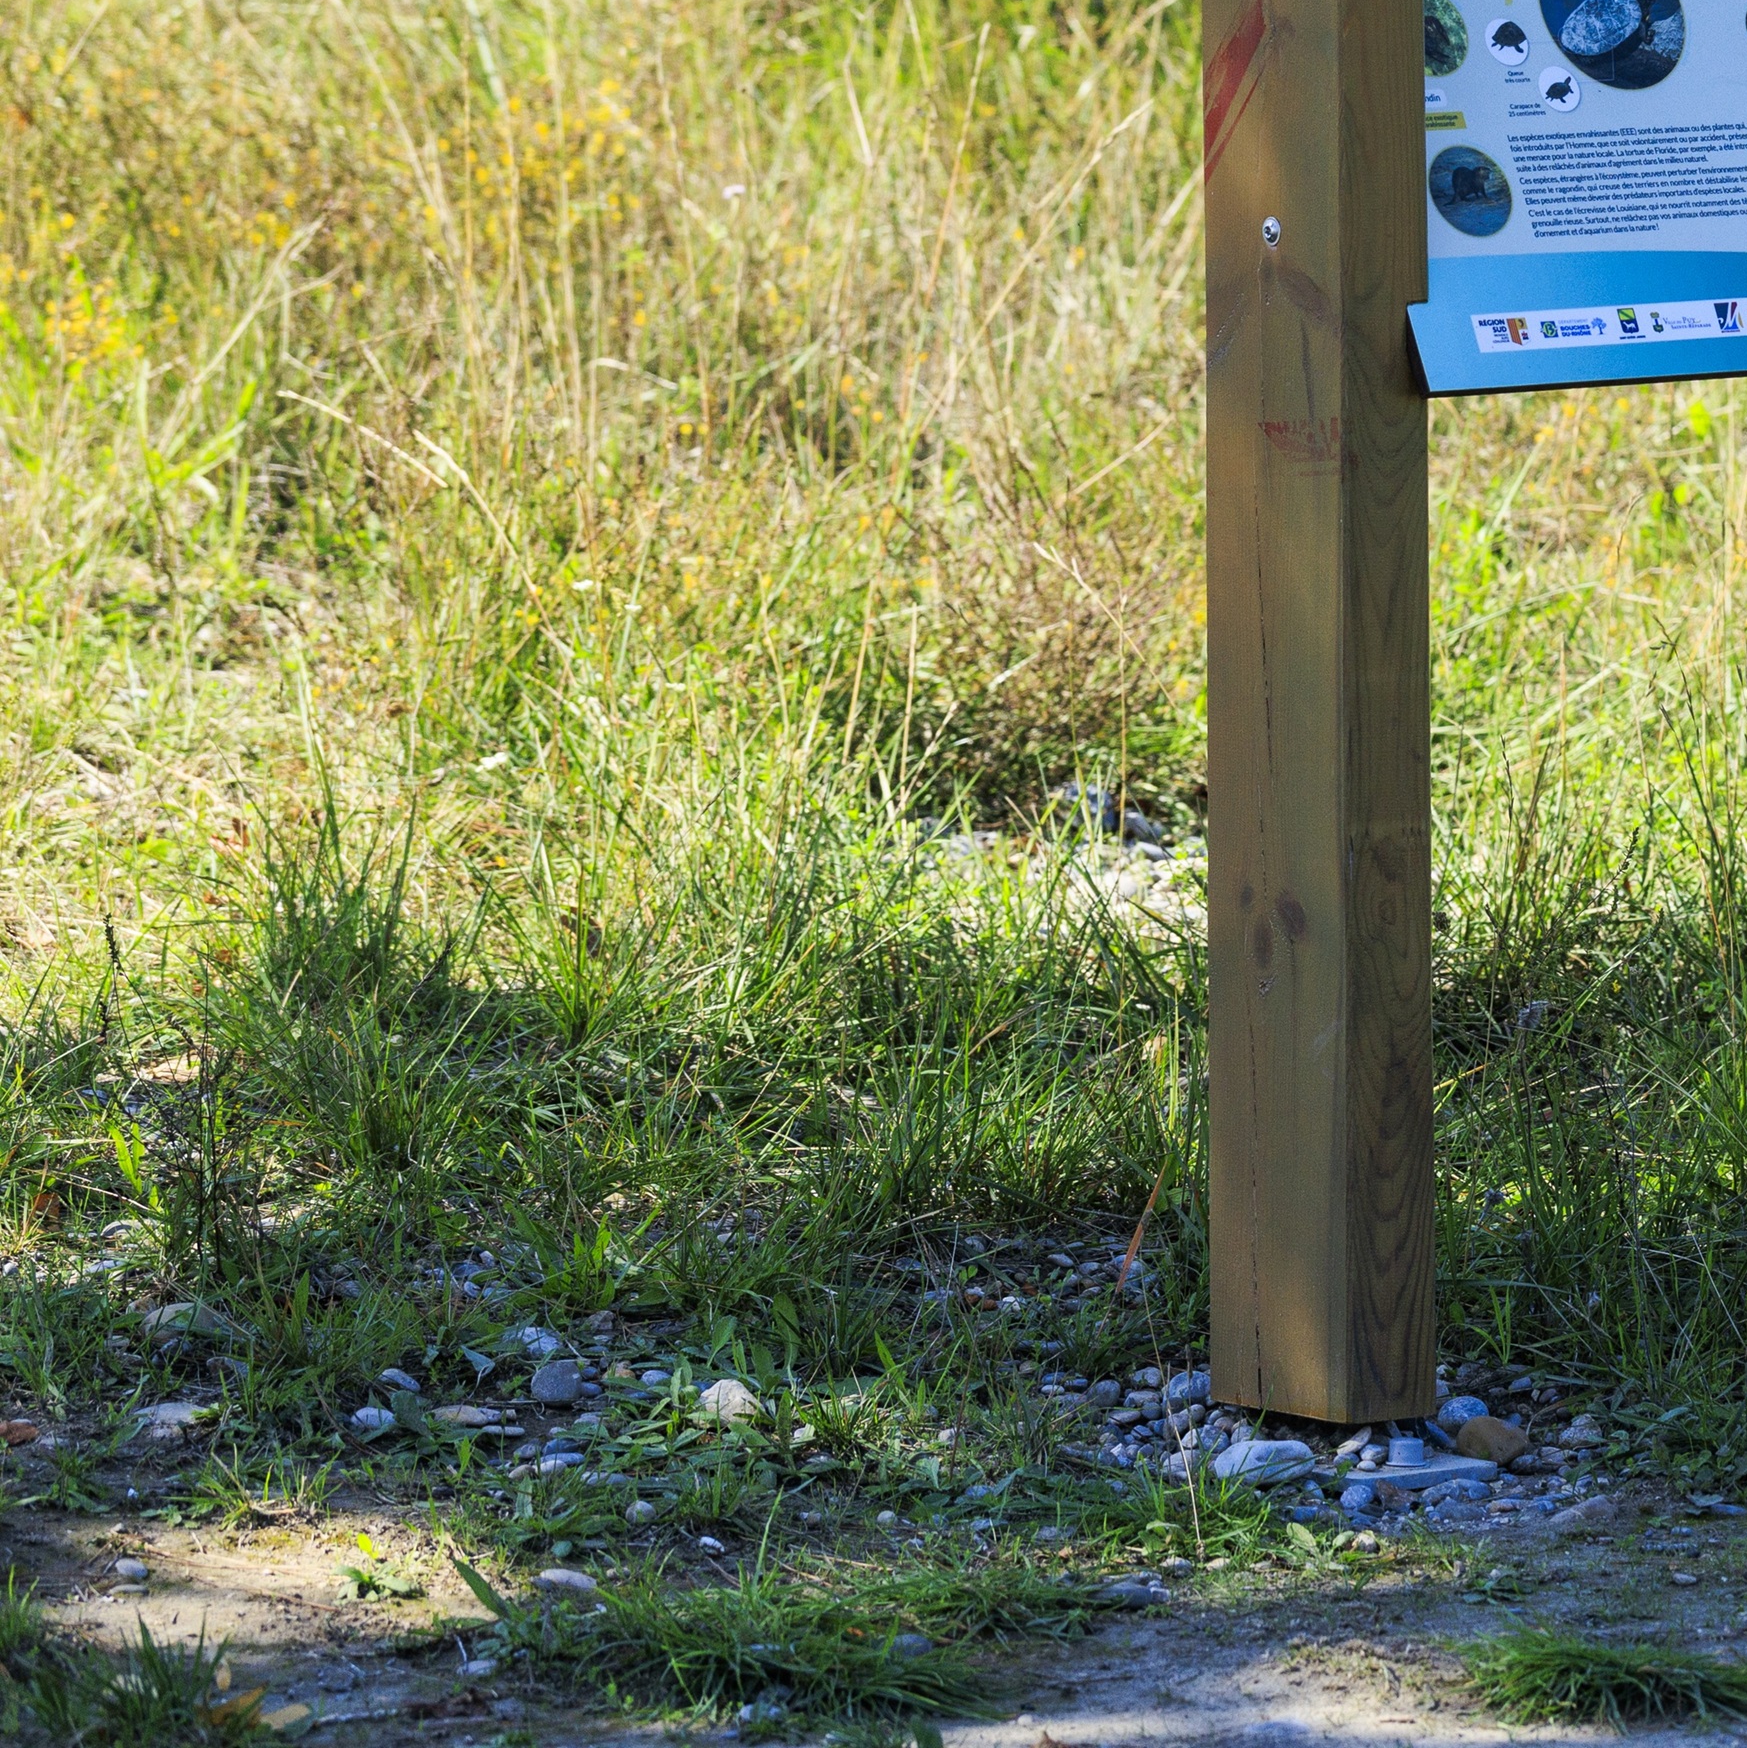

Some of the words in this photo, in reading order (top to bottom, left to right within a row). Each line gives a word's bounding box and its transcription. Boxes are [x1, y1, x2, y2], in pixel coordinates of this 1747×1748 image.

[1506, 134, 1519, 142] Les
[1519, 133, 1544, 142] espèces
[1544, 132, 1575, 140] exotiques
[1576, 129, 1619, 138] envahissantes
[1619, 127, 1637, 136] (EEE)
[1651, 126, 1663, 134] des
[1711, 123, 1734, 131] plantes
[1478, 318, 1505, 327] RÉGION
